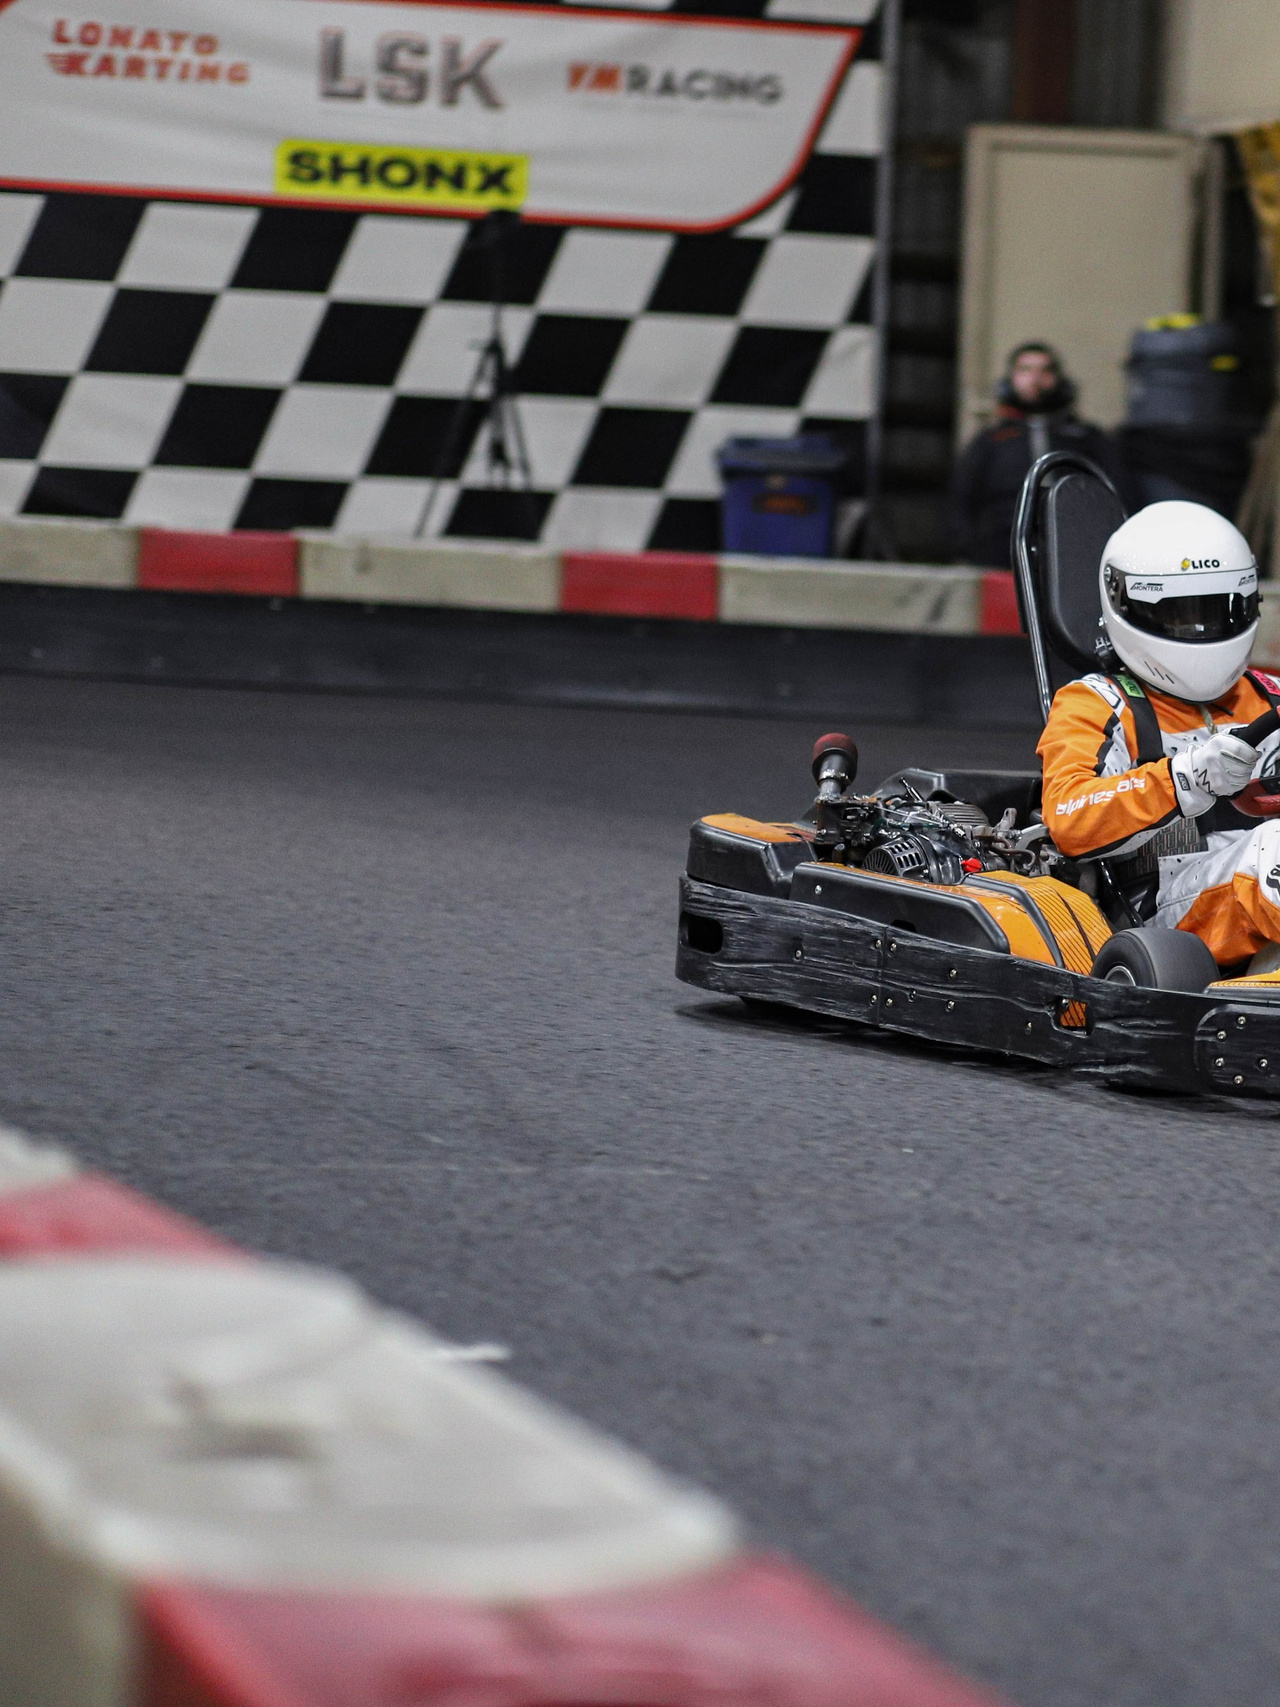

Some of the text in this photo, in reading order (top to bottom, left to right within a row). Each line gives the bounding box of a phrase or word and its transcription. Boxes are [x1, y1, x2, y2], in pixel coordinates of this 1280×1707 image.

[53, 19, 220, 56] LONATO
[47, 53, 249, 84] KARTING
[318, 27, 504, 112] LSK
[287, 148, 514, 196] SHONX
[1191, 560, 1220, 569] LICO
[1130, 583, 1163, 592] MONTERA
[1055, 777, 1146, 816] alpinesars
